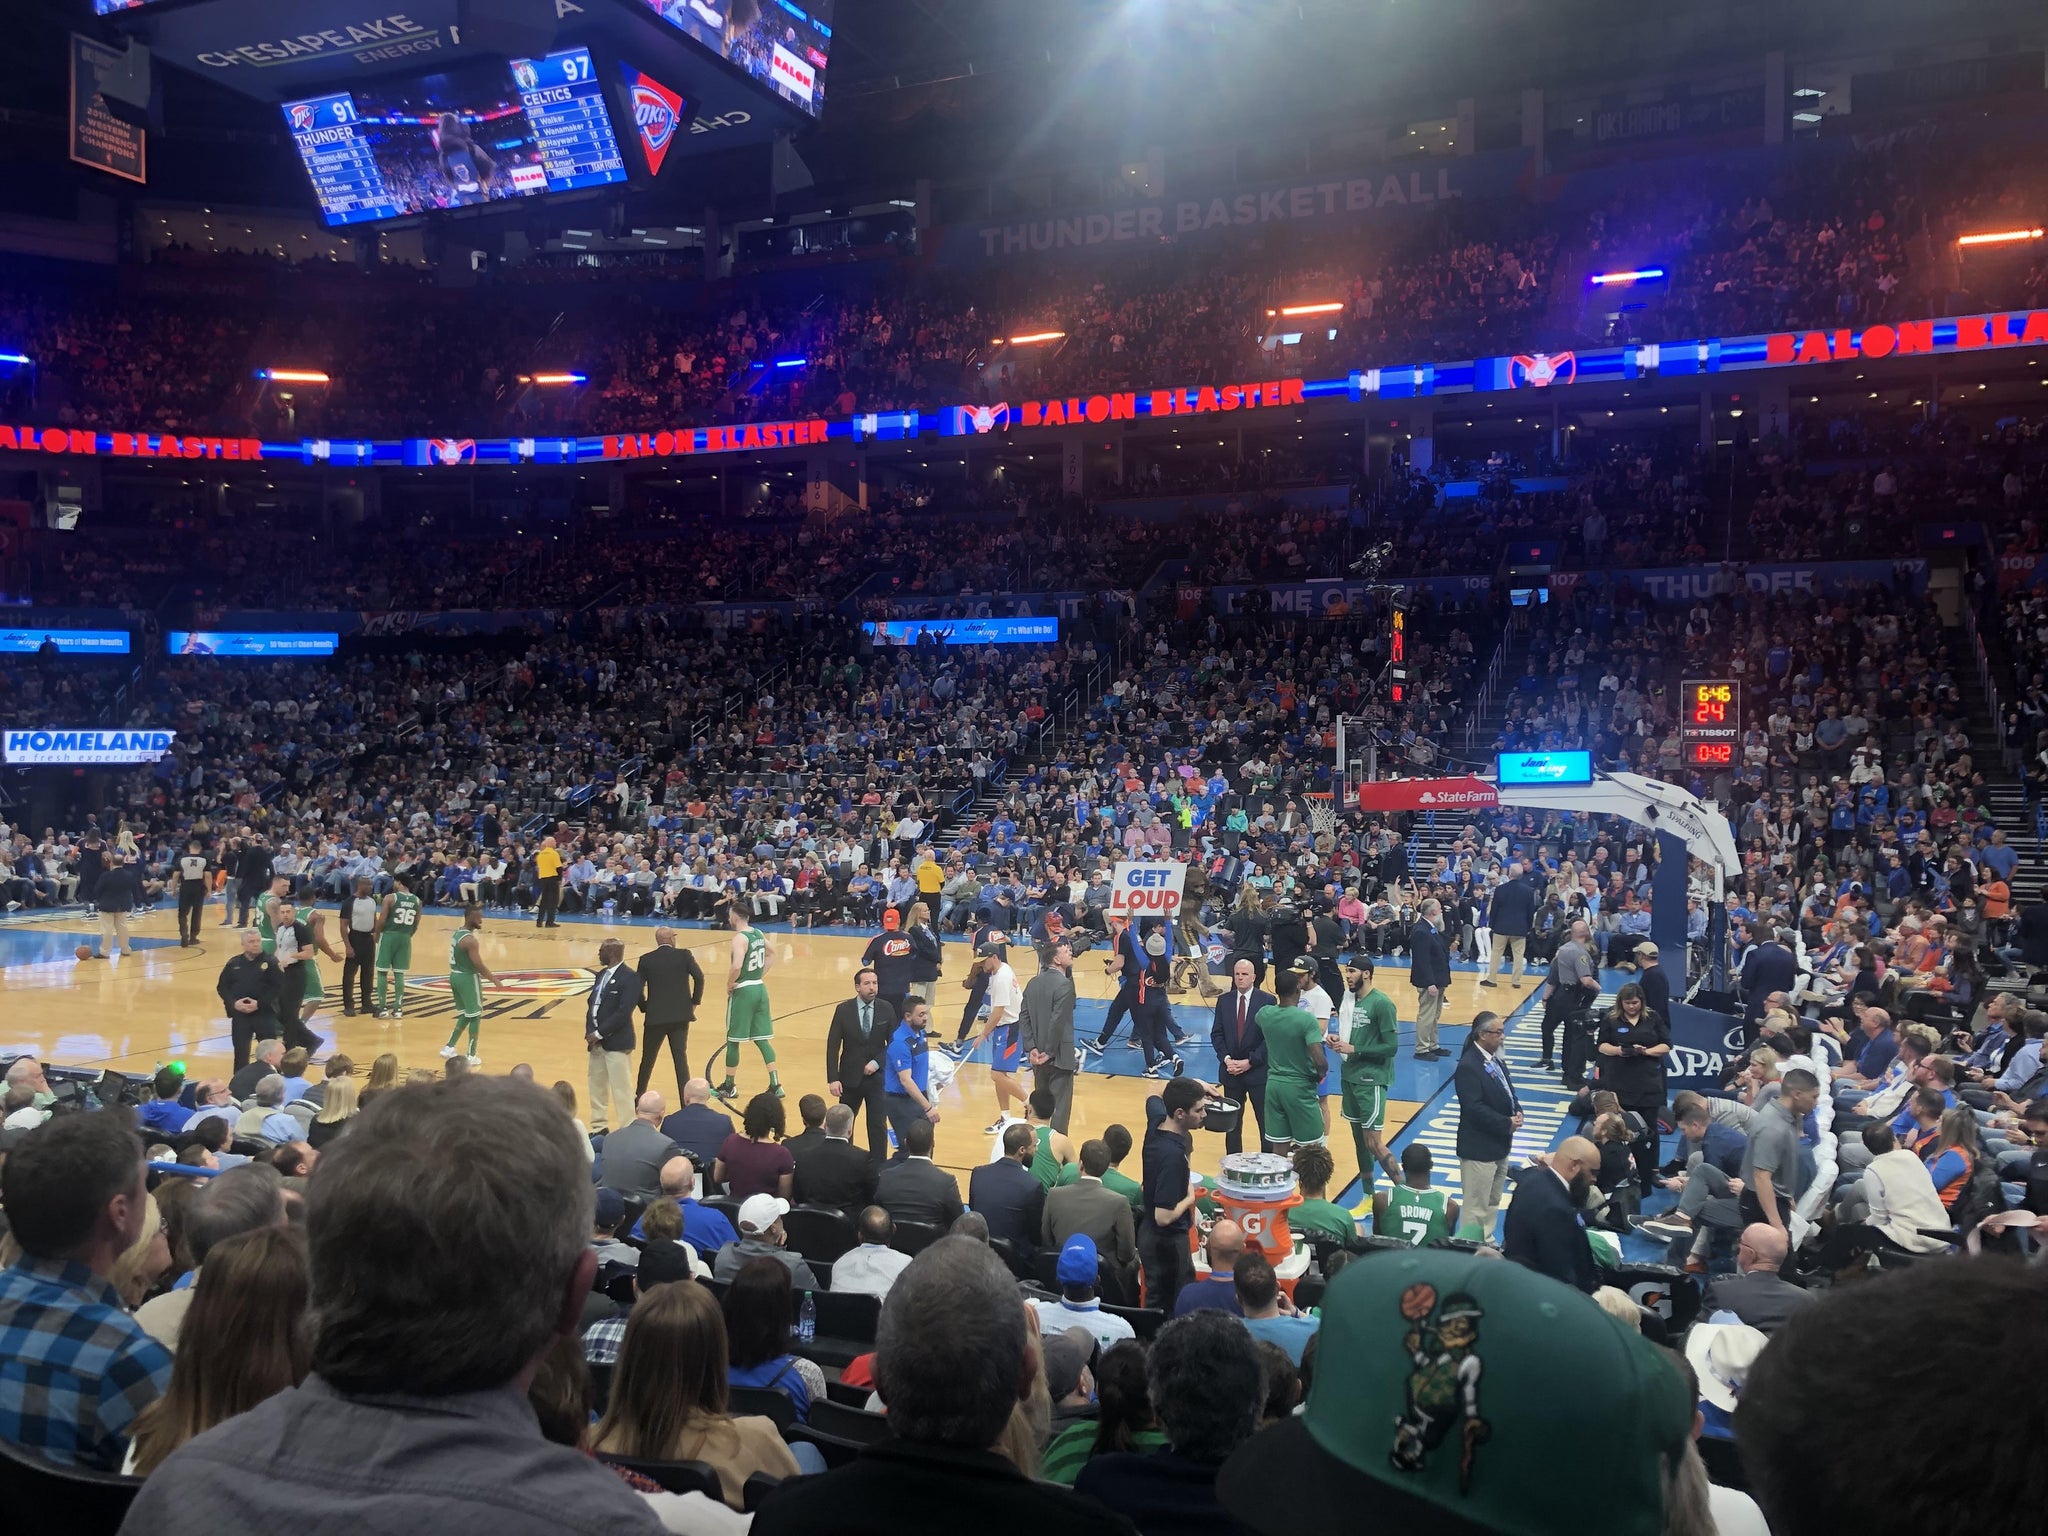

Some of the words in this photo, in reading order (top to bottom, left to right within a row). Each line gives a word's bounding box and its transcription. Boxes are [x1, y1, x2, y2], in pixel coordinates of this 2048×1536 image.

[197, 14, 424, 67] CHESAPEAKE
[354, 37, 441, 64] ENERGY
[562, 56, 589, 80] 97
[774, 56, 812, 88] BALON
[523, 88, 572, 106] CELTICS
[332, 100, 357, 122] 91
[540, 115, 565, 126] Walker
[636, 103, 667, 127] OKC
[79, 125, 138, 151] CONFERENCE
[88, 118, 130, 139] WESTERN
[294, 126, 355, 147] THUNDER
[543, 123, 584, 136] Wanamaker
[82, 135, 136, 160] CHAMPIONS
[547, 135, 578, 148] Hayward
[551, 148, 570, 158] Theis
[554, 158, 575, 168] Smart
[514, 172, 543, 184] BALON
[328, 194, 358, 205] Ferguson
[979, 207, 1163, 257] THUNDER
[1176, 168, 1462, 232] BASKETBALL
[1767, 319, 1934, 365] BALON
[1022, 392, 1136, 427] BALON
[1150, 377, 1305, 416] BLASTER
[111, 432, 263, 461] BLASTER
[603, 429, 695, 460] BALON
[706, 419, 829, 452] BLASTER
[1069, 453, 1077, 486] 207
[2000, 556, 2036, 569] 108
[1462, 577, 1489, 590] 106
[1550, 574, 1578, 587] 107
[1178, 589, 1201, 601] 106
[1017, 626, 1033, 634] What
[314, 640, 333, 649] Results
[1697, 685, 1731, 702] 6:46
[1696, 701, 1724, 722] 24
[9, 731, 171, 751] HOMELAND
[1700, 729, 1736, 737] TISSOT
[34, 752, 70, 761] fresh
[1521, 756, 1551, 768] Jani
[1698, 744, 1731, 761] 0:42
[1666, 810, 1703, 840] SPALDING
[1126, 869, 1171, 887] GET
[1111, 889, 1180, 910] LOUD
[393, 908, 417, 926] 36
[748, 947, 765, 972] 20
[1400, 1205, 1433, 1220] BROWN
[1242, 1213, 1262, 1234] G
[1402, 1221, 1427, 1246] 7
